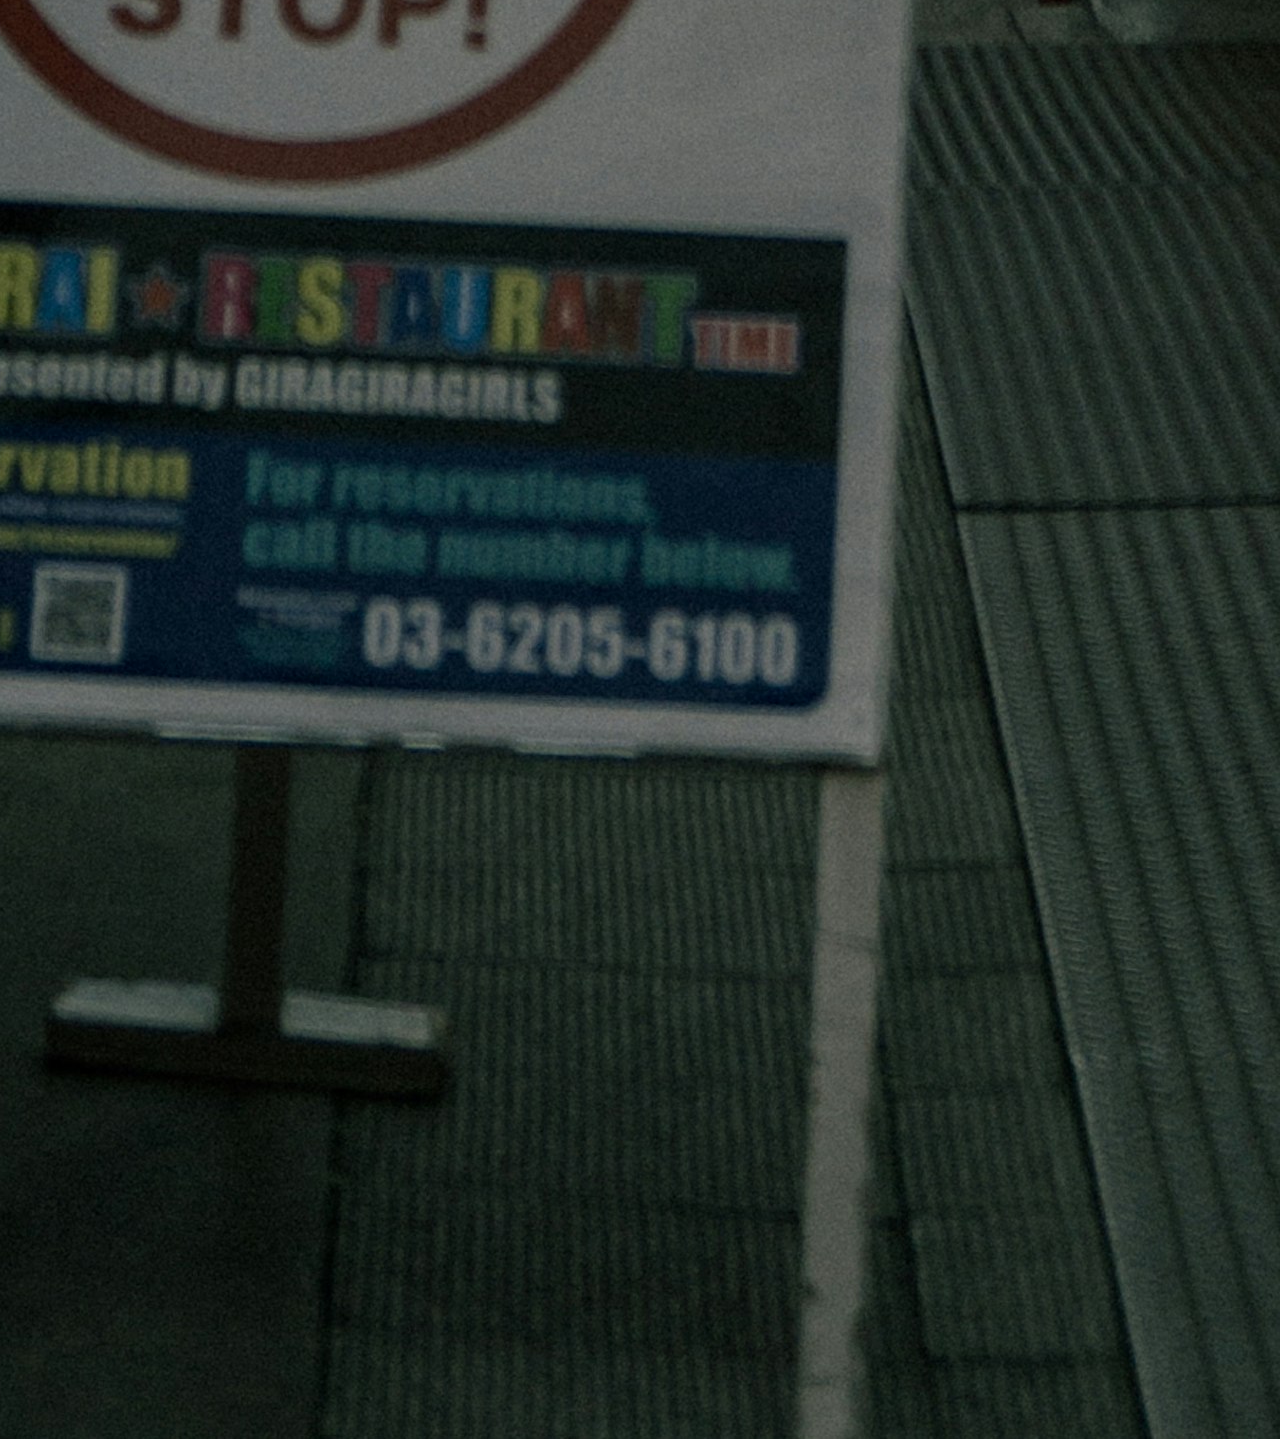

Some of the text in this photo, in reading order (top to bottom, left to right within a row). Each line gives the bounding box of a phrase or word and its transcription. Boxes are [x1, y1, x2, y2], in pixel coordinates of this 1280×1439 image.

[200, 257, 699, 367] RESTAURANT
[170, 349, 228, 412] by
[235, 359, 562, 422] GIRAGIRAGIRLS
[363, 594, 799, 688] 03-6205-6100
